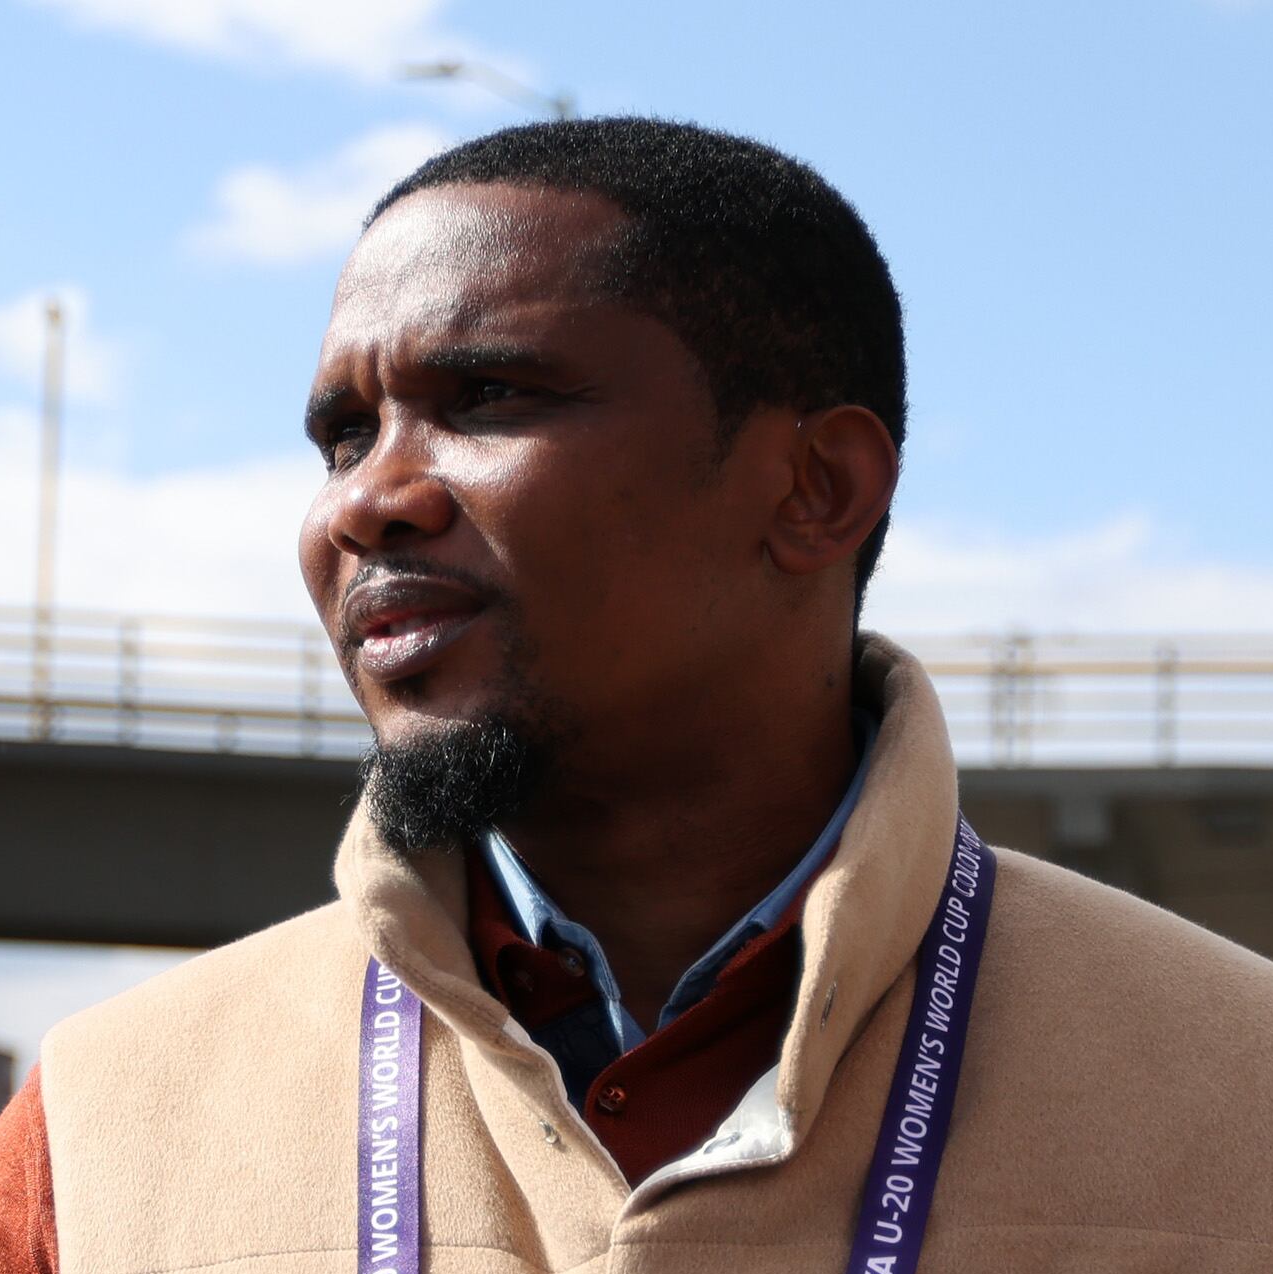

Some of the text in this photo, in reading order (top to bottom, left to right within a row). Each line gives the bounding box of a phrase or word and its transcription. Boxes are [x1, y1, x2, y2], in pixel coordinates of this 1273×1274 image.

[942, 896, 970, 943] CUP
[925, 944, 962, 1033] WORLD
[371, 1010, 401, 1111] WORLD
[890, 1033, 945, 1165] WOMEN'S
[371, 1116, 398, 1263] WOMEN'S
[873, 1174, 914, 1244] U-20
